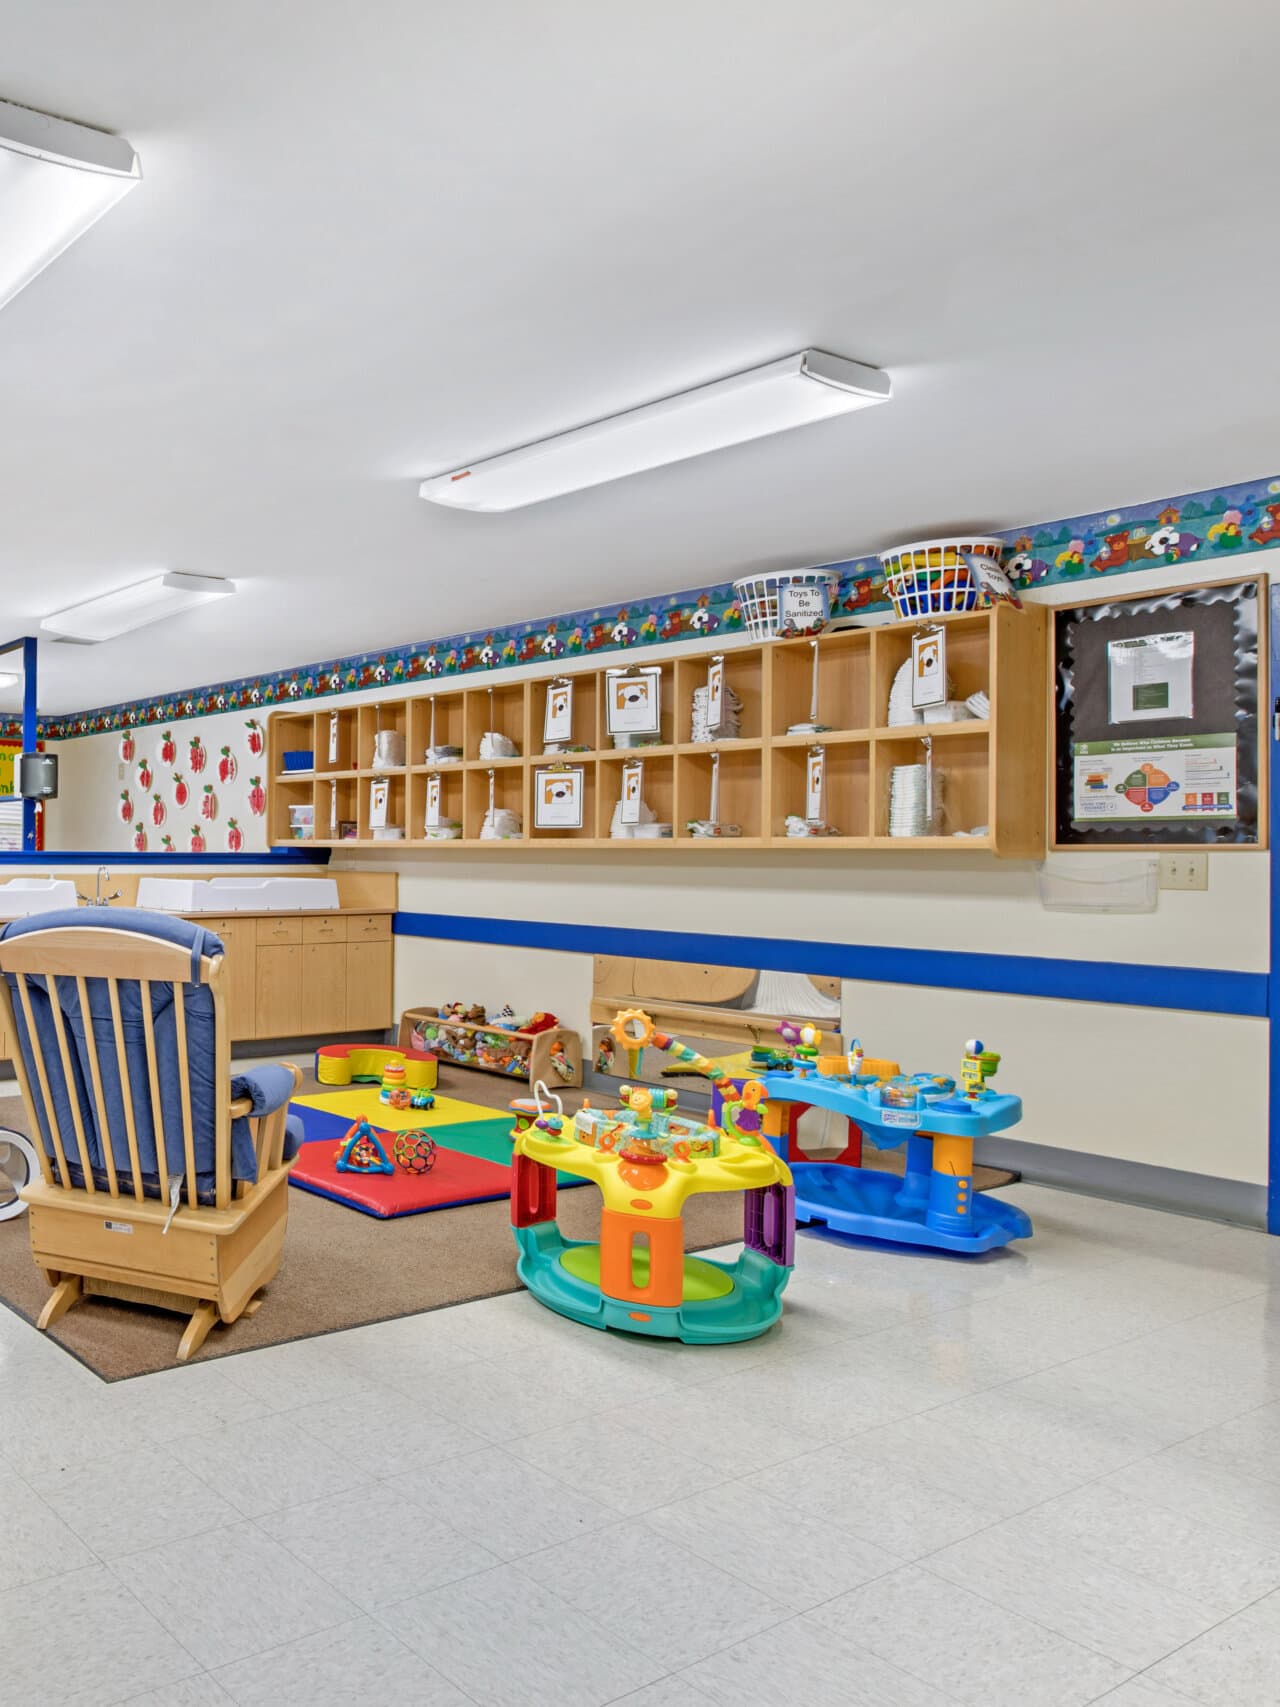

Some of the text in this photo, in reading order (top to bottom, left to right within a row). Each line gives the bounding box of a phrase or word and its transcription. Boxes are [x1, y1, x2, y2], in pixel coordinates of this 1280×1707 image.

[788, 589, 820, 598] Toys To
[798, 599, 811, 607] Be
[785, 610, 824, 618] Sanitized
